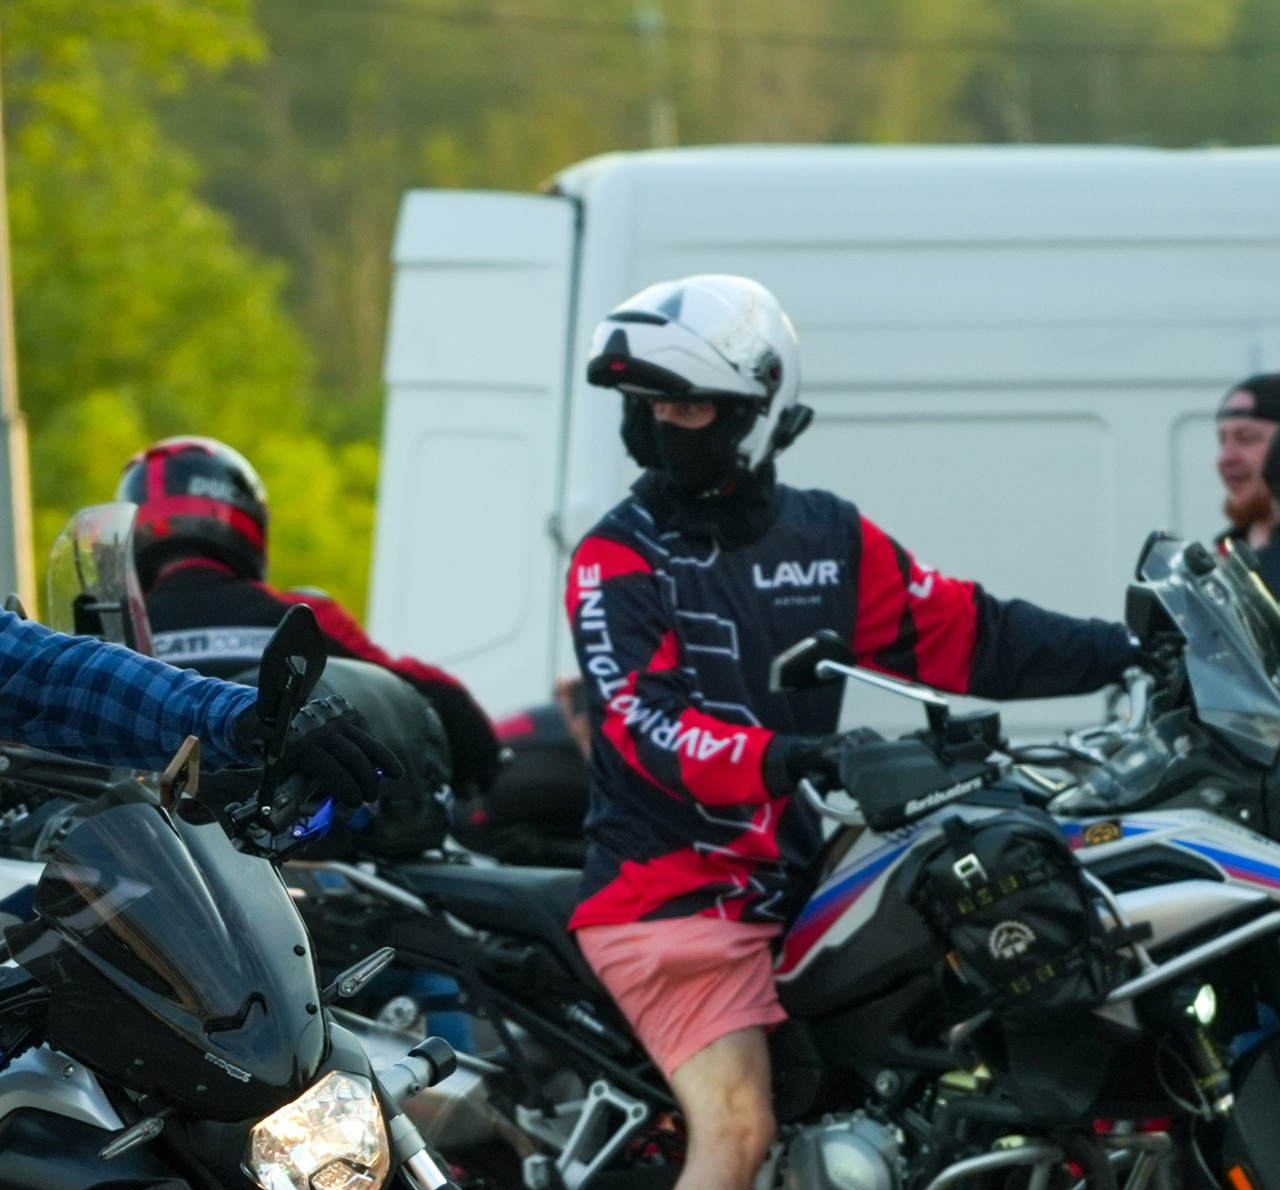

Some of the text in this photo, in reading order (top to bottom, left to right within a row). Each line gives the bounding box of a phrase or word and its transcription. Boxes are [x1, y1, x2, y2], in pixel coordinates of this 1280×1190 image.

[751, 558, 840, 589] LAVR
[155, 633, 270, 656] CATI CORS
[904, 777, 982, 816] Barkbusters
